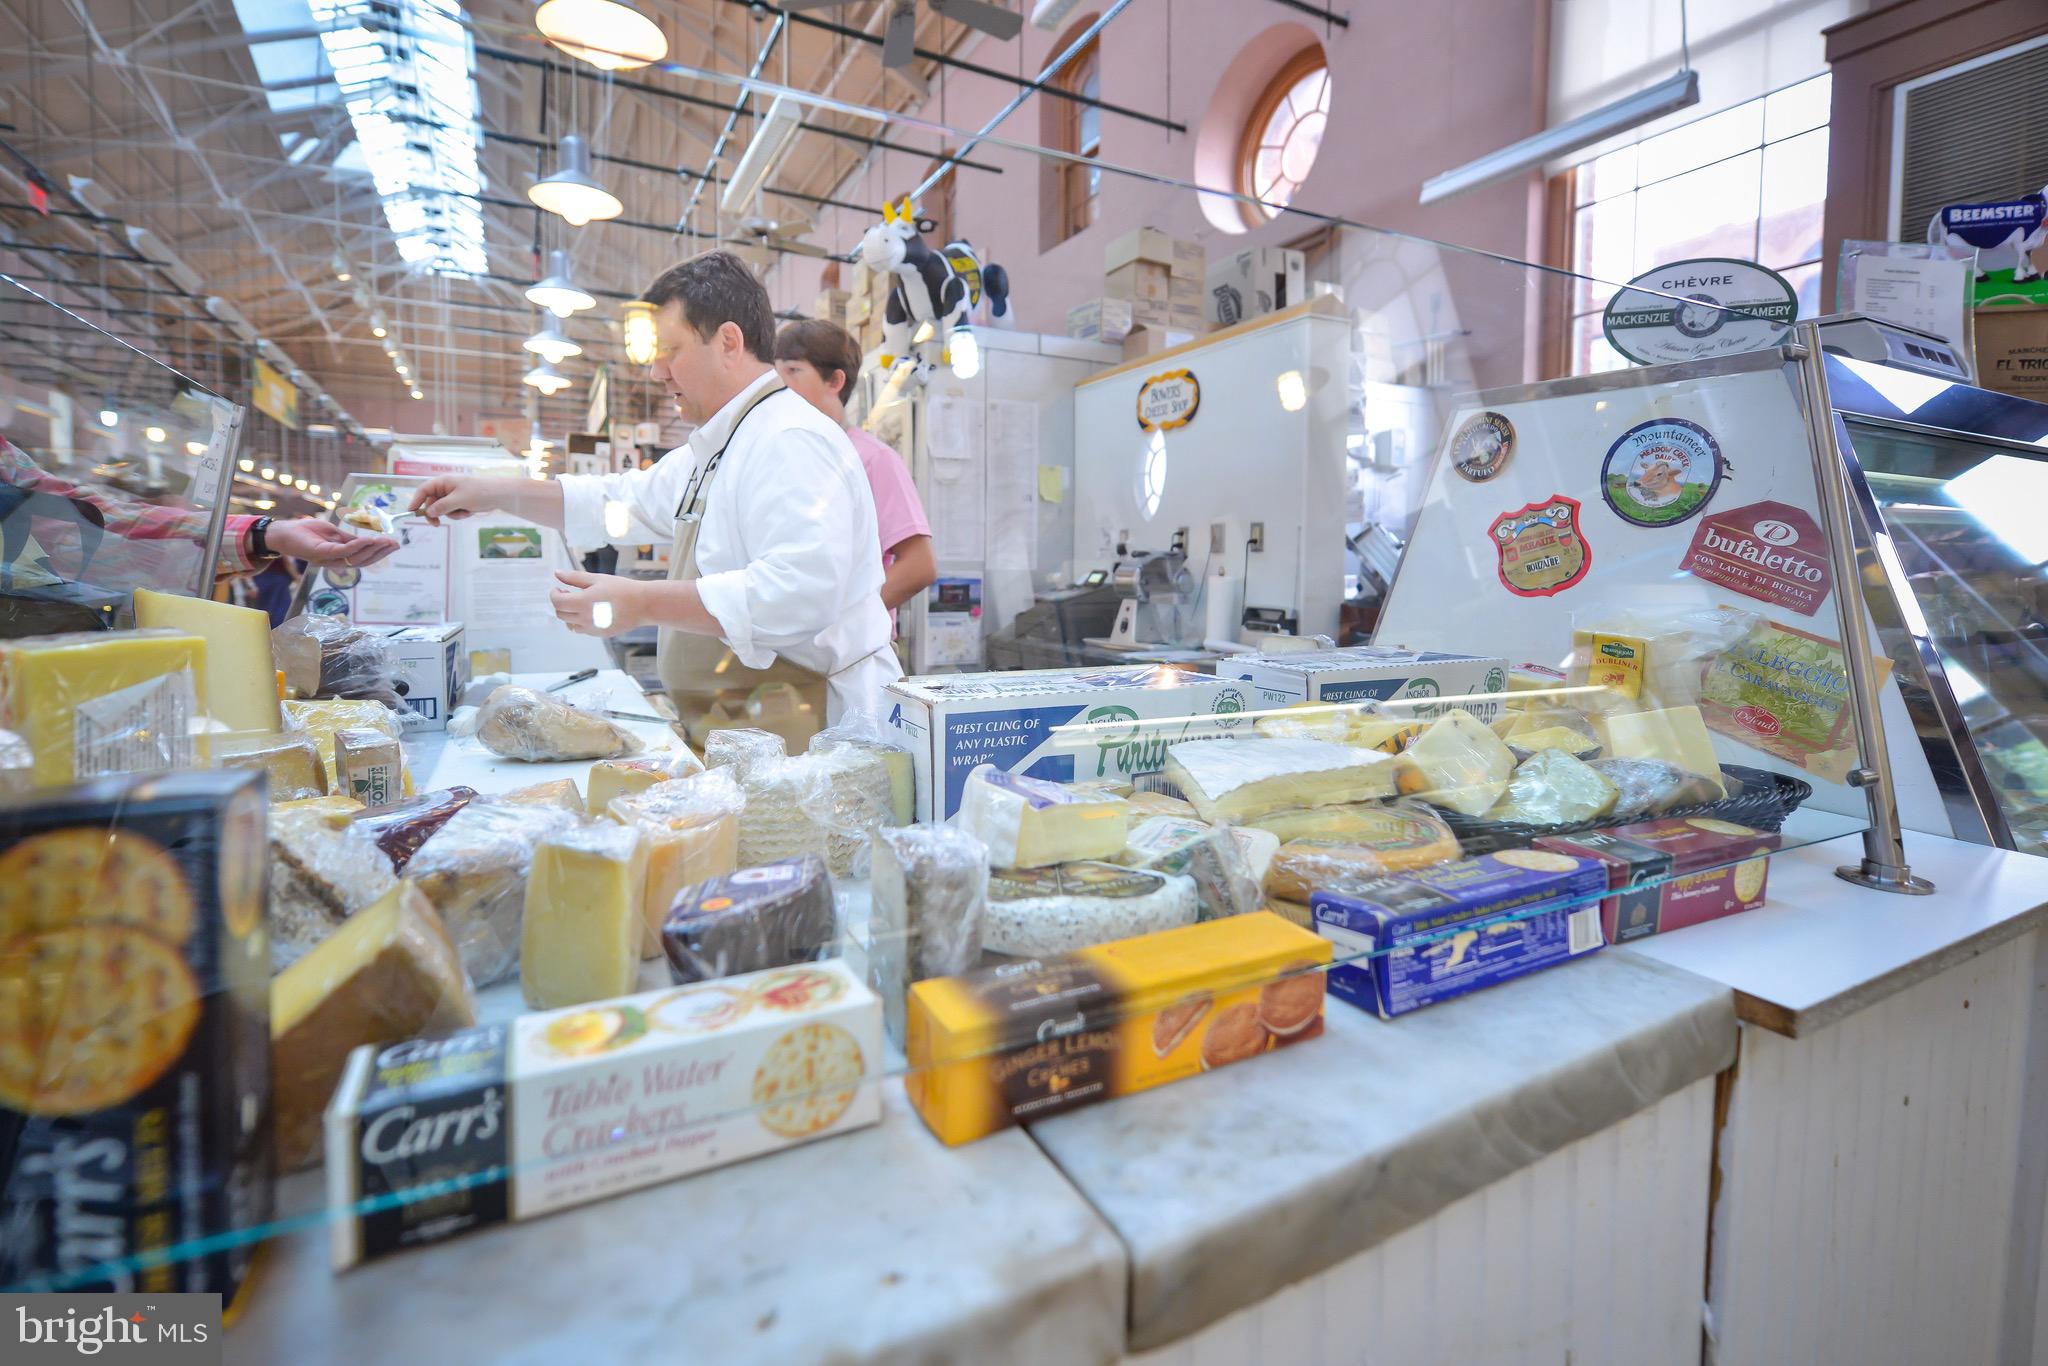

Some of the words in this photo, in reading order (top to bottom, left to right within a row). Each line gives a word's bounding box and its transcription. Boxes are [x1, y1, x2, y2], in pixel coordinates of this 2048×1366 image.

[1949, 204, 2035, 223] BEEMSTER
[1661, 275, 1733, 290] CHÈVRE
[1606, 311, 1671, 326] MACKENZIE
[1632, 429, 1706, 458] Mountaineer
[1639, 446, 1672, 459] MEADOW
[1673, 448, 1690, 468] CREEK
[1703, 527, 1823, 584] bufaletto
[1694, 554, 1715, 566] CON
[1718, 563, 1750, 579] LATTE
[1754, 574, 1767, 585] DI
[1771, 581, 1813, 602] BUFALA
[1595, 657, 1639, 672] DUBLINER
[1742, 646, 1849, 693] LEGGIO
[1263, 691, 1287, 704] PW122
[1404, 690, 1430, 700] ANCHOR
[985, 720, 1020, 732] CLING
[1023, 718, 1041, 730] OF
[955, 738, 981, 750] ANY
[983, 735, 1029, 748] PLASTIC
[1087, 704, 1180, 778] Purit
[543, 1072, 633, 1121] Table
[642, 1053, 733, 1097] Water
[361, 1086, 501, 1165] Carr's
[20, 1137, 128, 1292] arr's
